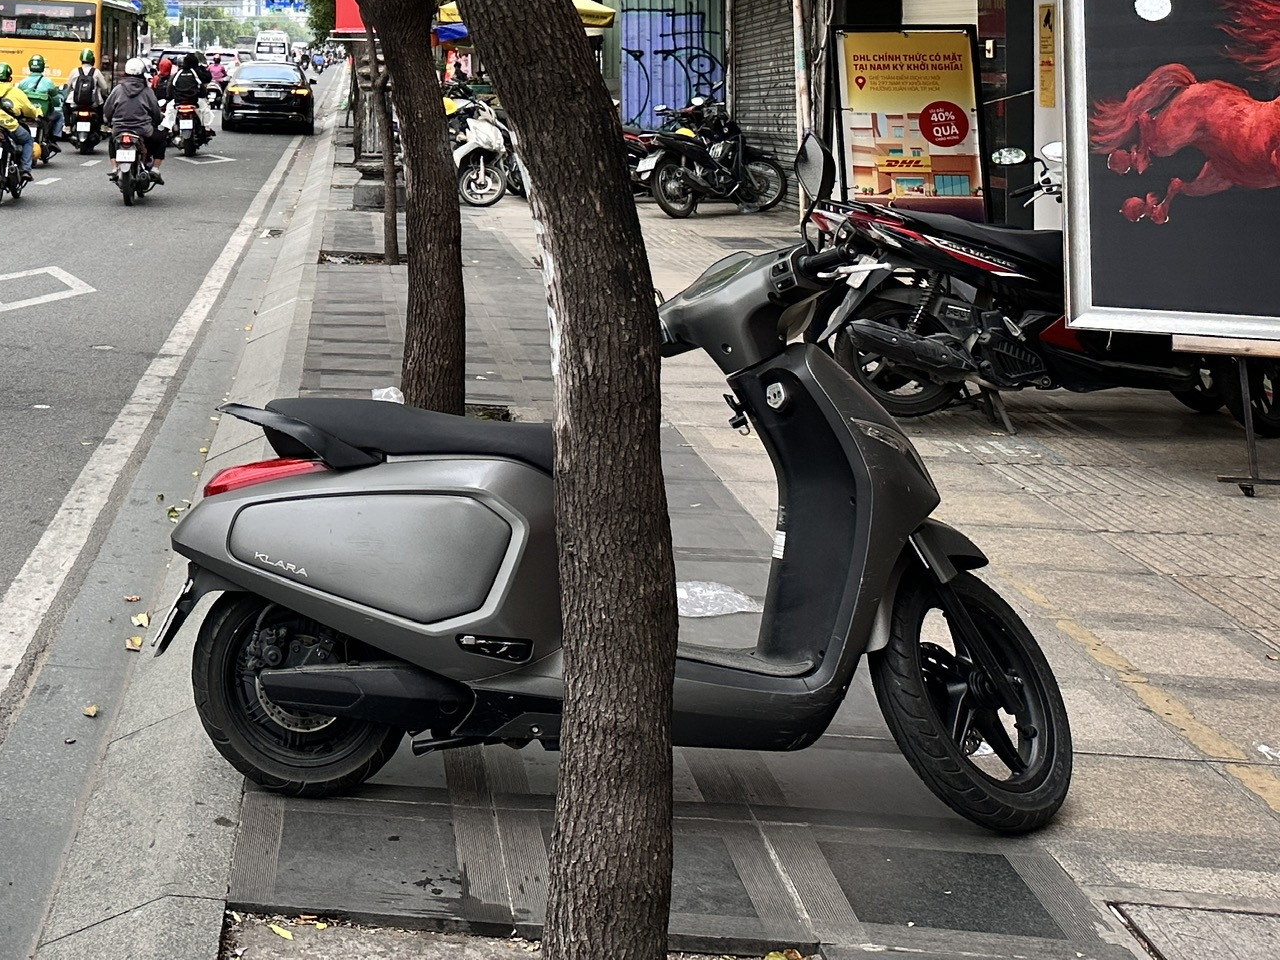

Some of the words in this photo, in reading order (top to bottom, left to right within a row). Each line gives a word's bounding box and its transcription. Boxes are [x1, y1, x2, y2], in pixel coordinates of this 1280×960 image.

[853, 54, 871, 62] DHL
[873, 52, 901, 62] CHÍNH
[902, 52, 928, 62] THỨC
[929, 52, 942, 62] CÓ
[943, 53, 963, 63] MẶT
[853, 64, 868, 72] TẠI
[870, 63, 891, 71] NAM
[892, 62, 904, 71] KỲ
[906, 61, 929, 71] KHỞI
[930, 61, 963, 71] NGHĨA!
[931, 111, 955, 122] 40%
[933, 122, 959, 137] QUÀ
[885, 159, 924, 168] DHL
[254, 551, 308, 578] KLARA
